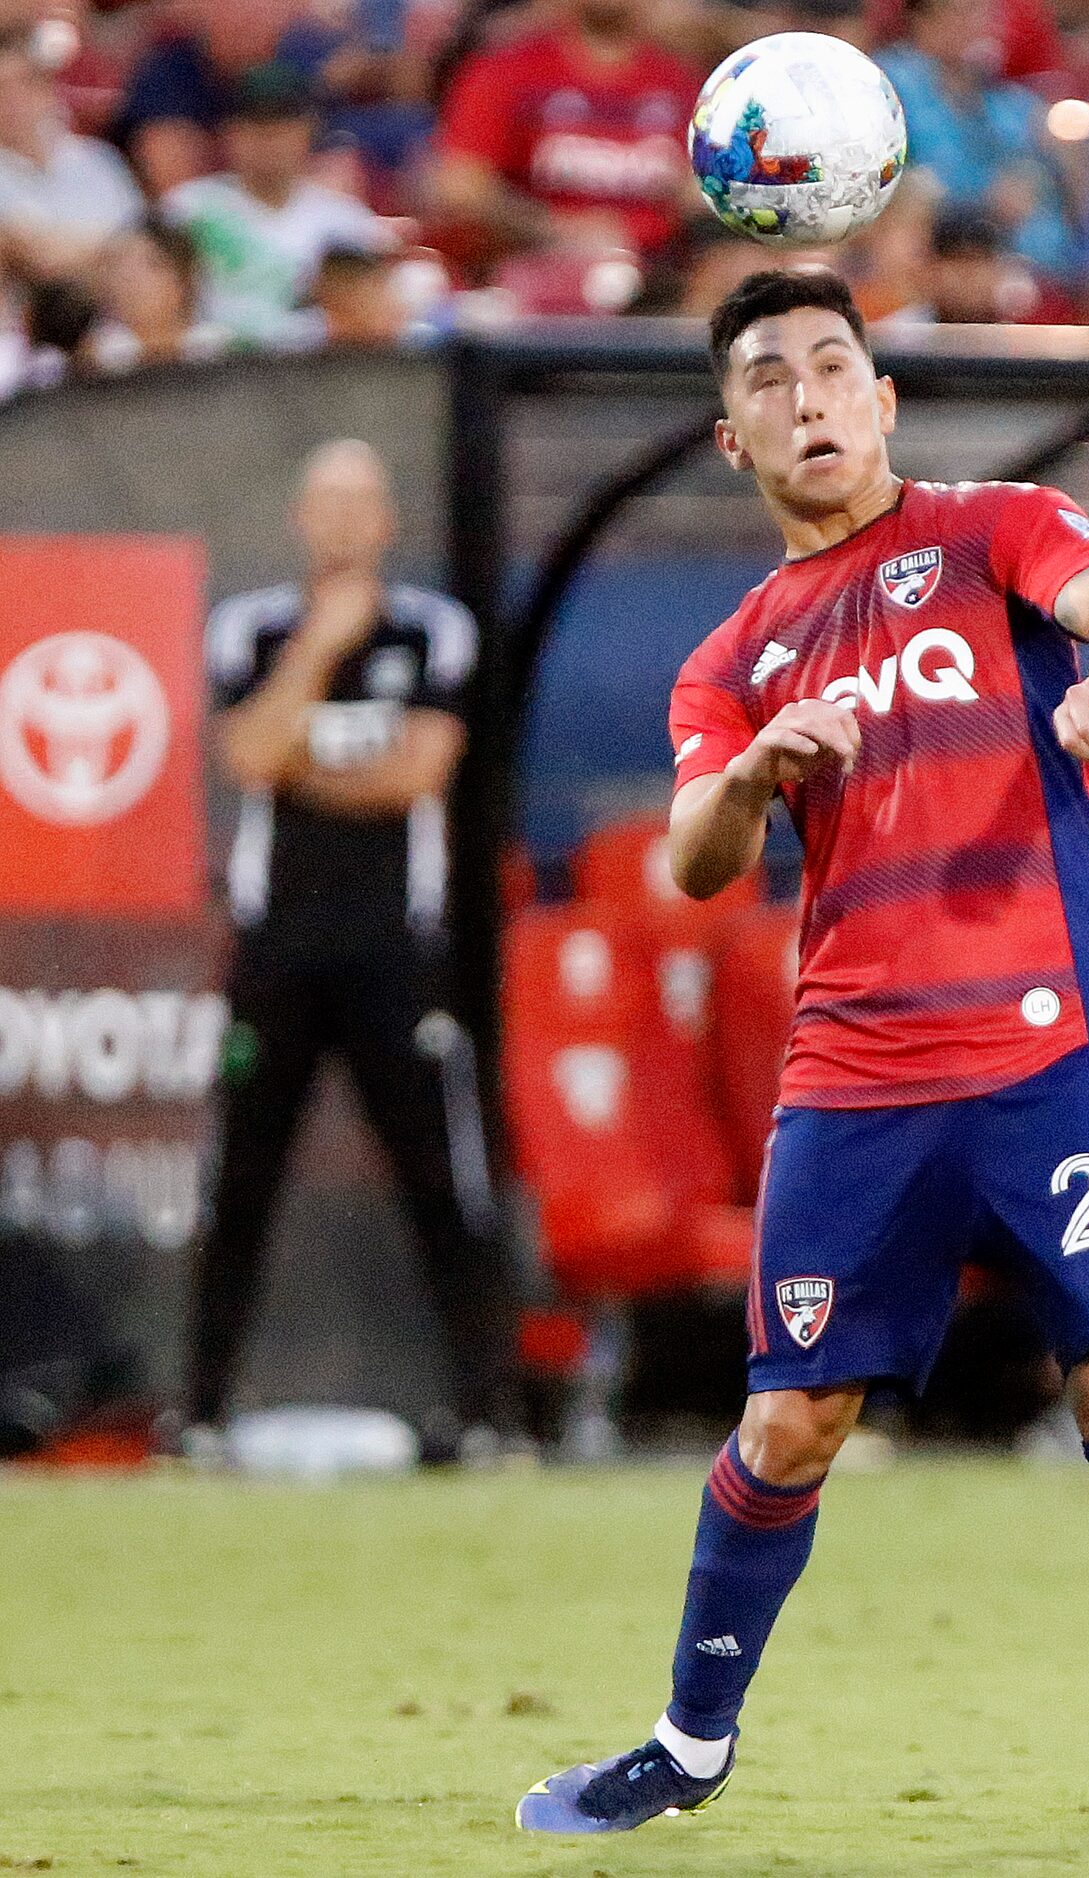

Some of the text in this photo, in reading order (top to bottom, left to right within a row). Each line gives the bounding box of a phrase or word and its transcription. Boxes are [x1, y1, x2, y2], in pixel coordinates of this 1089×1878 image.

[885, 550, 938, 578] FC DALLAS
[1031, 1000, 1051, 1014] LH
[781, 1282, 828, 1303] FC DALLAS
